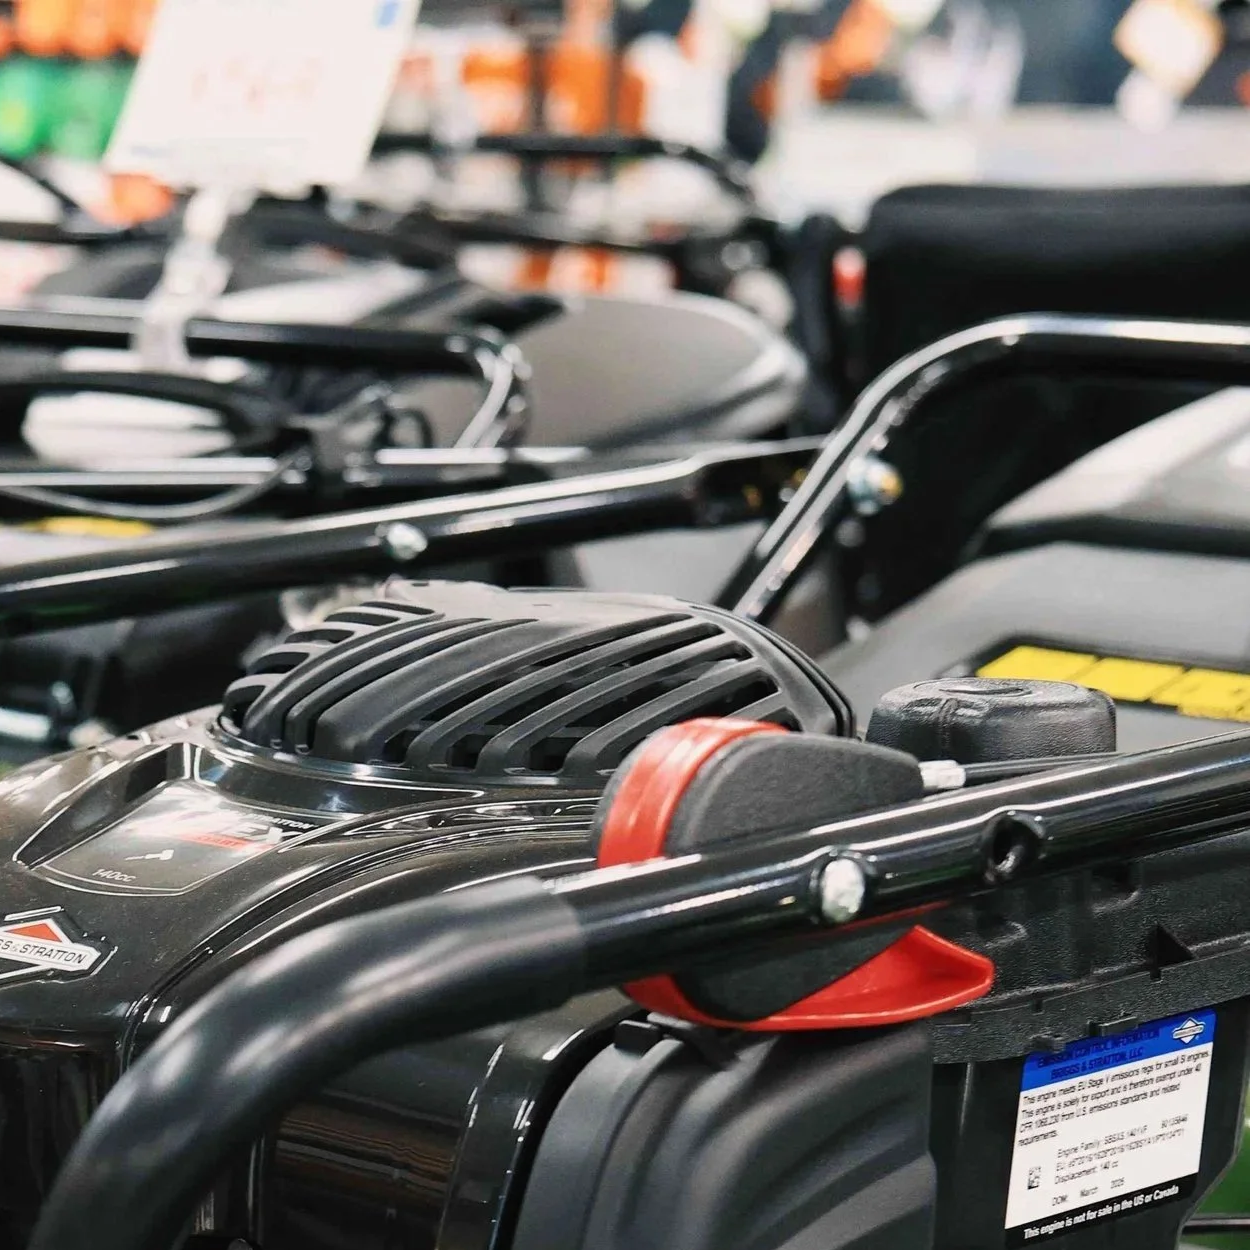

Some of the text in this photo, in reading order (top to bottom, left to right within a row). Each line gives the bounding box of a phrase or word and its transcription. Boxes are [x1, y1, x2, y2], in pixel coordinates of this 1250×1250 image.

[19, 943, 87, 965] STRATTON
[1021, 1109, 1034, 1119] This
[1035, 1105, 1056, 1116] engine
[1063, 1097, 1080, 1109] solely
[1090, 1089, 1110, 1101] export
[1110, 1085, 1122, 1095] and
[1128, 1077, 1154, 1090] therefore
[1155, 1072, 1177, 1084] exempt
[1177, 1066, 1194, 1078] under
[1023, 1095, 1036, 1105] This
[1037, 1091, 1057, 1103] engine
[1059, 1085, 1076, 1095] meets
[1088, 1078, 1104, 1089] Stage
[1110, 1068, 1140, 1082] emissions
[1141, 1064, 1154, 1075] regs
[1164, 1056, 1179, 1068] small
[1060, 1111, 1075, 1121] from
[1089, 1100, 1119, 1114] emissions
[1120, 1092, 1148, 1106] standards
[1149, 1088, 1160, 1098] and
[1057, 1146, 1079, 1159] Engine
[1080, 1186, 1099, 1198] March
[1023, 1185, 1179, 1239] This engine is not for sale in the US or Canada
